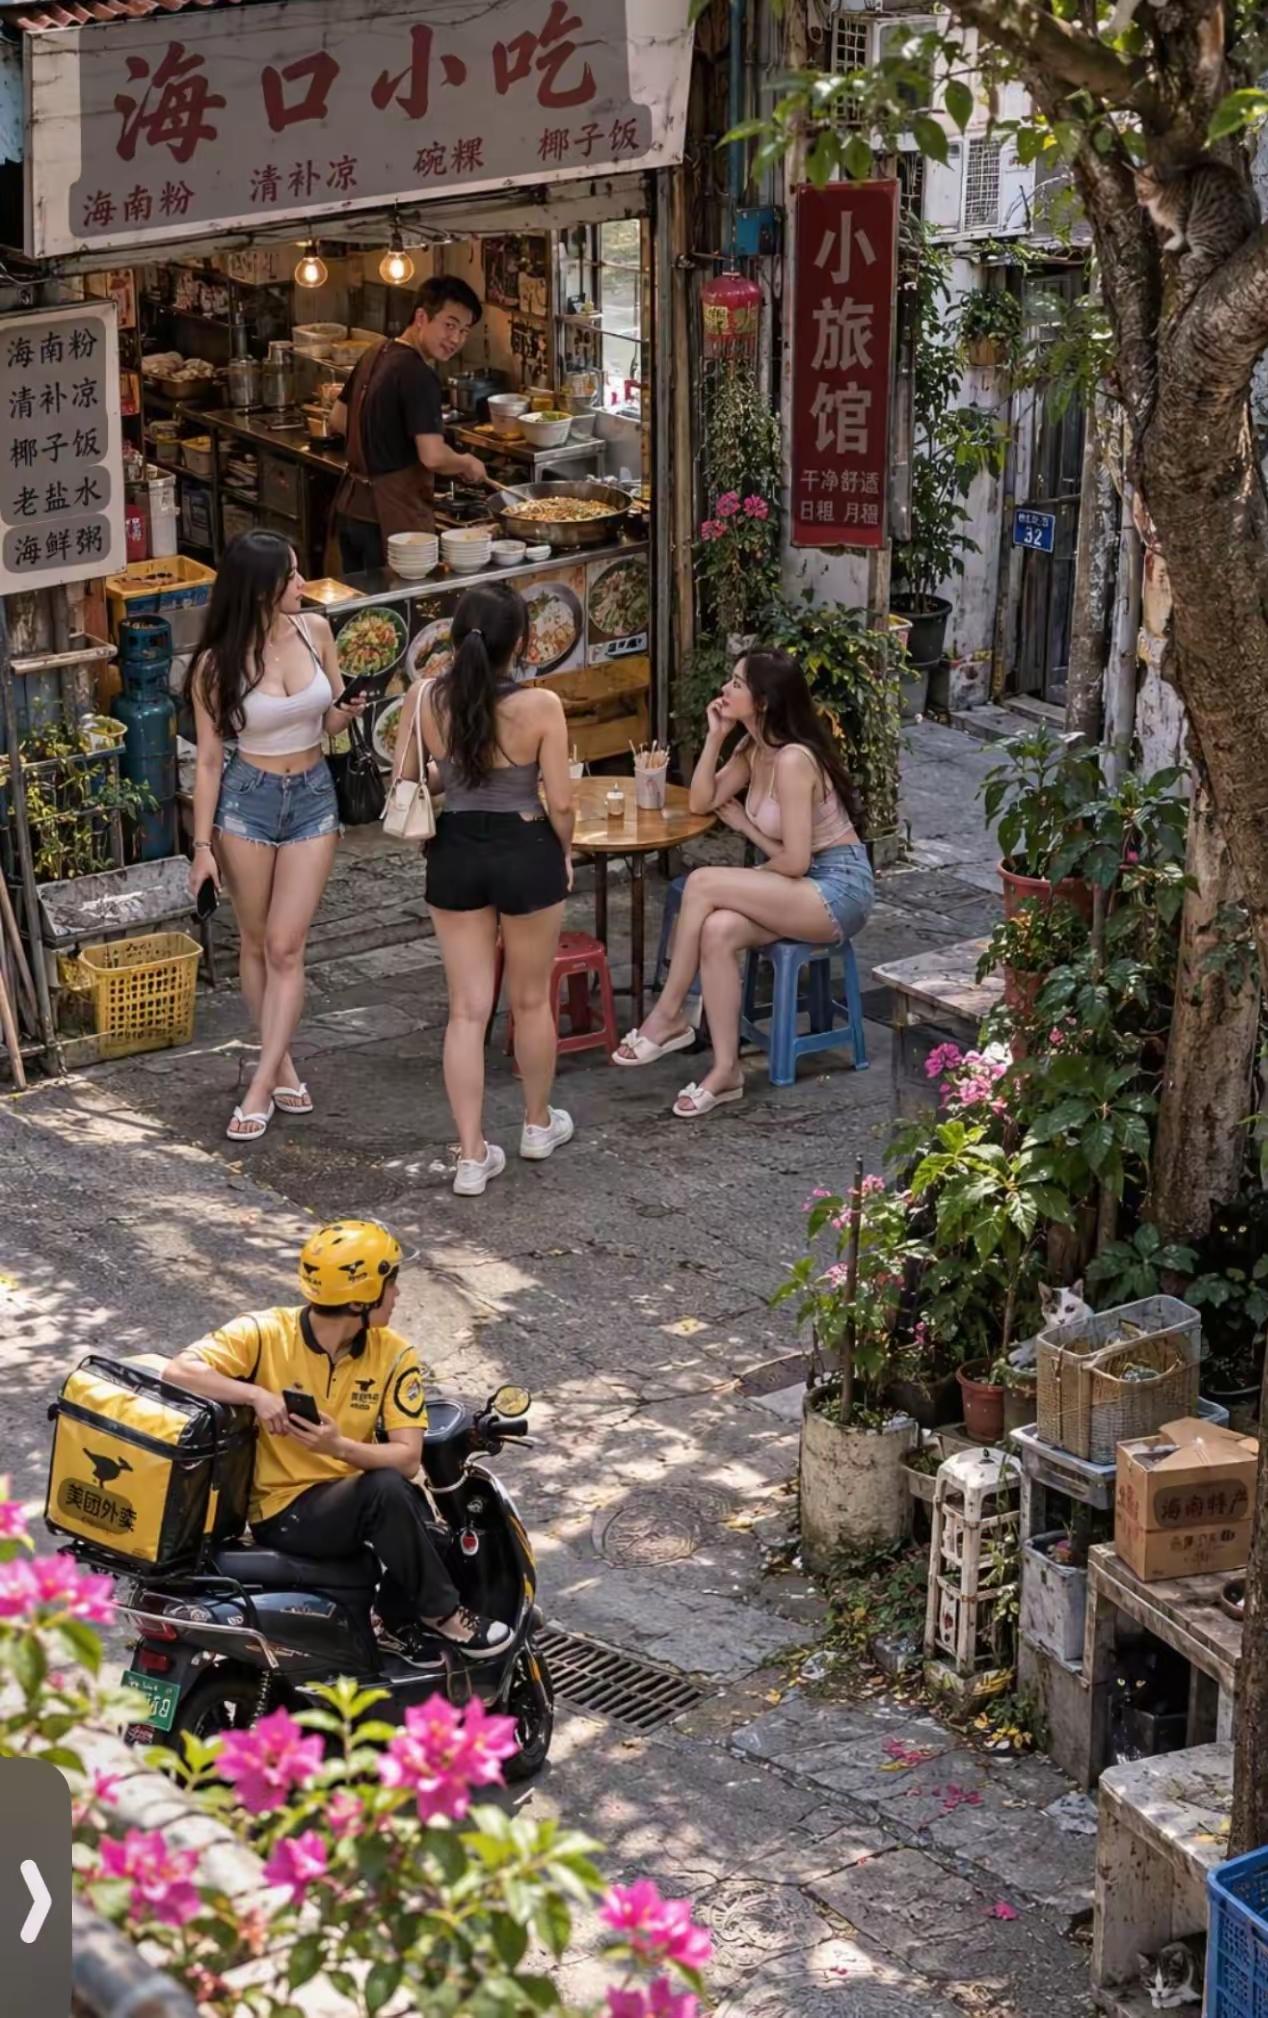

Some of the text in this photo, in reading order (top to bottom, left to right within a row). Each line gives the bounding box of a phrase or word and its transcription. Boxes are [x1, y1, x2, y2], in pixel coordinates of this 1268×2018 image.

[115, 1, 597, 163] 海口小吃
[83, 118, 640, 227] 海南粉 清补凉 碗粿 椰子饭
[7, 328, 97, 368] 海南粉
[810, 210, 878, 455] 小旅馆
[9, 377, 98, 419] 清补凉
[10, 428, 100, 468] 椰子饭
[13, 476, 102, 517] 老盐水
[800, 469, 880, 494] 干净舒适
[801, 500, 834, 521] 日租
[15, 525, 102, 566] 海鲜粥
[1023, 526, 1042, 546] 32
